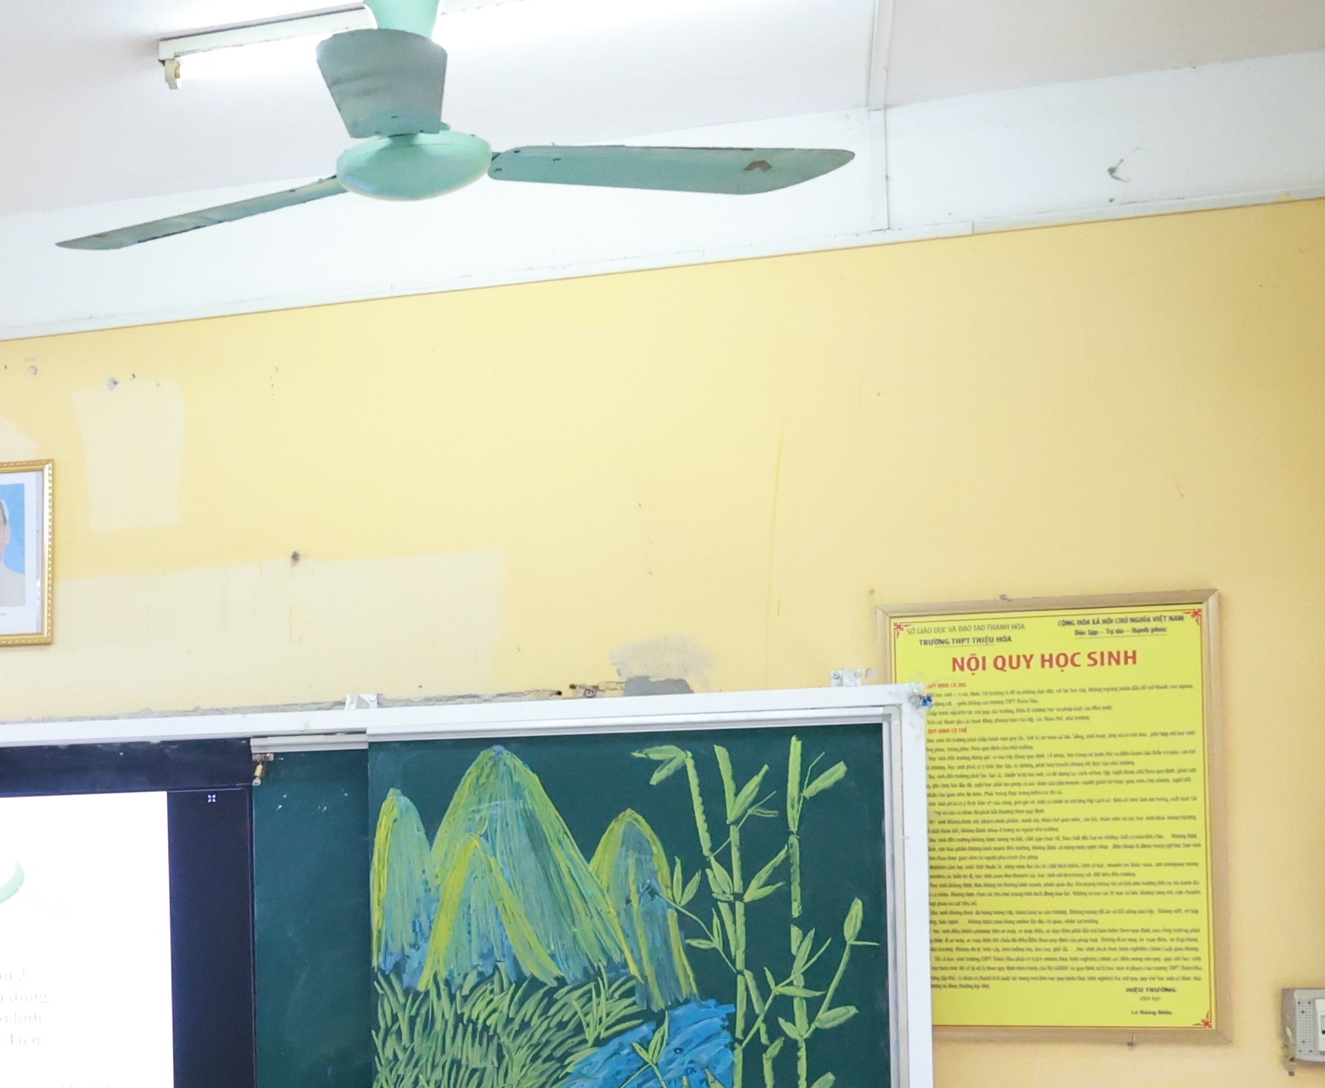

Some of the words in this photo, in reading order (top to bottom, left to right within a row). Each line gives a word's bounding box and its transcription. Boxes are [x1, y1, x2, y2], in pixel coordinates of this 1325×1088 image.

[952, 653, 986, 676] NỘI
[993, 653, 1034, 672] QUY
[1040, 652, 1081, 673] HỌC
[1087, 649, 1137, 667] SINH
